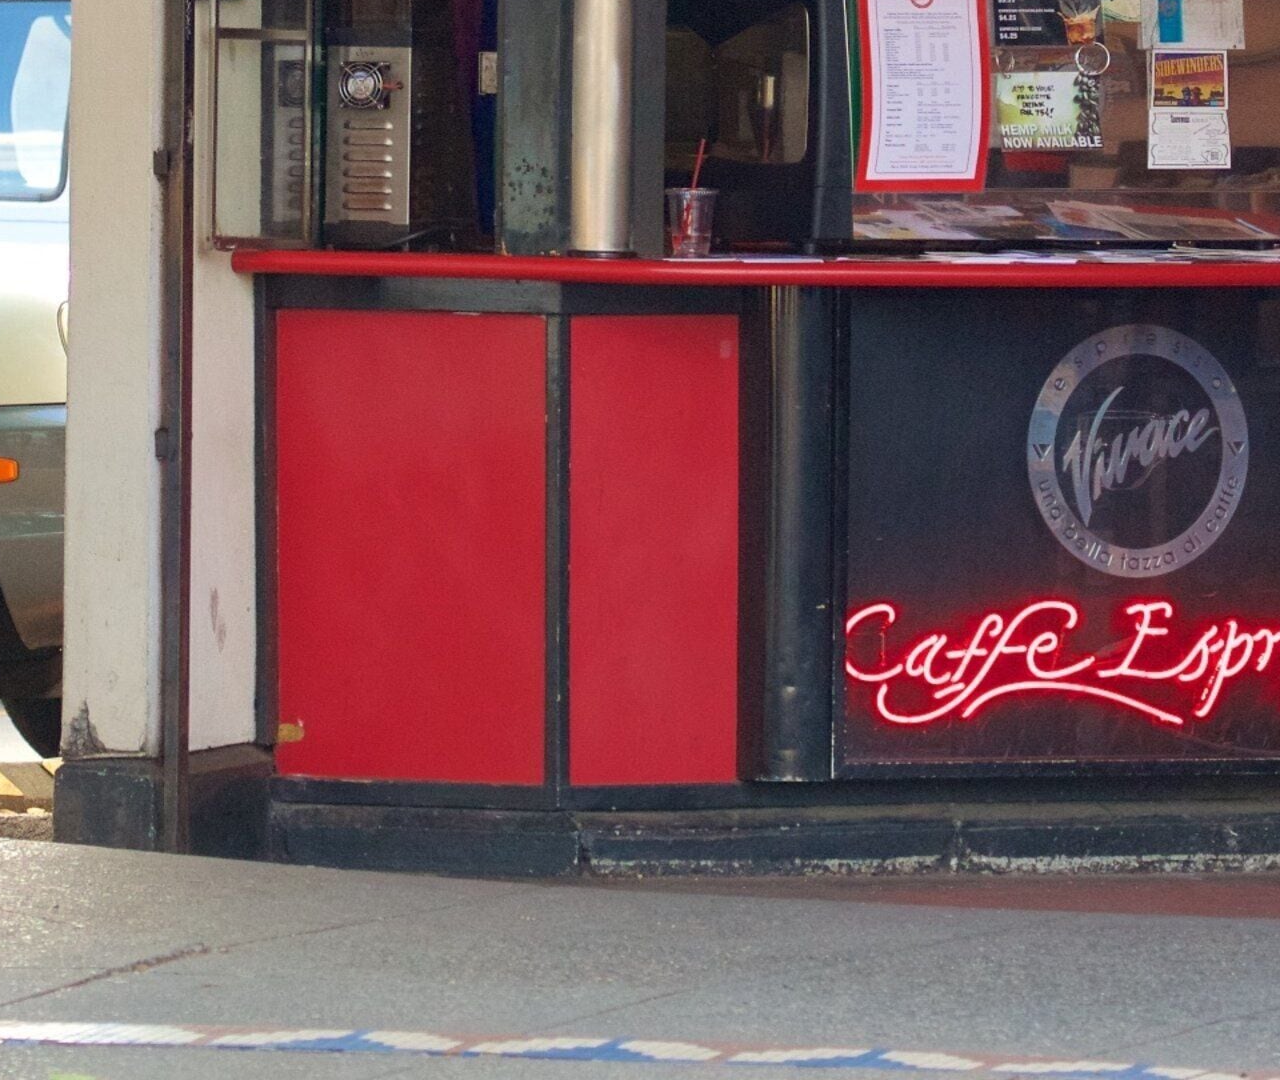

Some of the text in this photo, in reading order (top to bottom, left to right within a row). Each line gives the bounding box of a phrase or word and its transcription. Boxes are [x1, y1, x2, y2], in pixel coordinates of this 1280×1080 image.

[1155, 55, 1224, 77] SIDEWINDERS
[1001, 123, 1073, 136] HEMP MILK
[1003, 135, 1103, 149] NOW AVAILABLE
[1053, 332, 1223, 391] espresso
[1062, 385, 1220, 528] Vivace
[1039, 479, 1062, 520] una
[1062, 522, 1114, 567] bella
[1121, 550, 1179, 571] tazza
[1183, 532, 1203, 555] di
